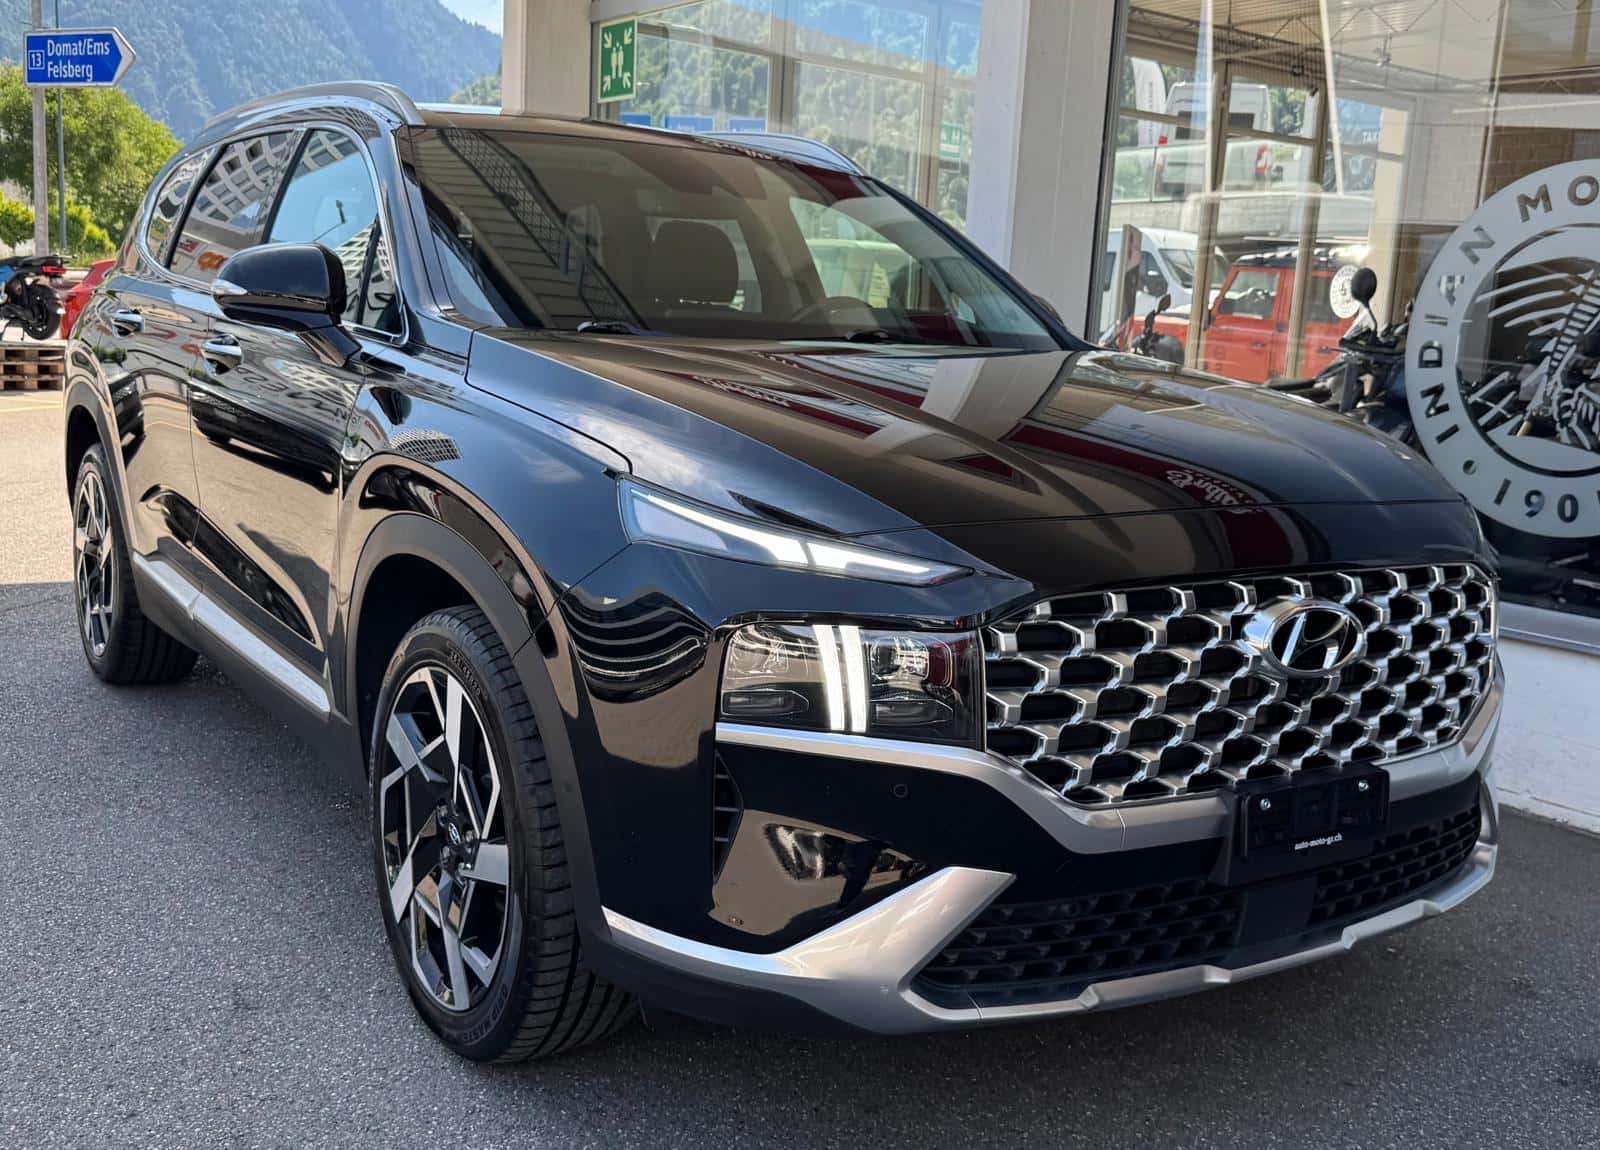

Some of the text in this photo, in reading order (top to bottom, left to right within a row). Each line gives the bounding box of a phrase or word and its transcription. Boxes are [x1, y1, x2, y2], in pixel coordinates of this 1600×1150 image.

[47, 38, 110, 56] Domat/Ems
[31, 53, 42, 67] 13
[47, 60, 93, 81] Felsberg
[1418, 225, 1495, 445] INDIAN
[1494, 479, 1600, 523] 190
